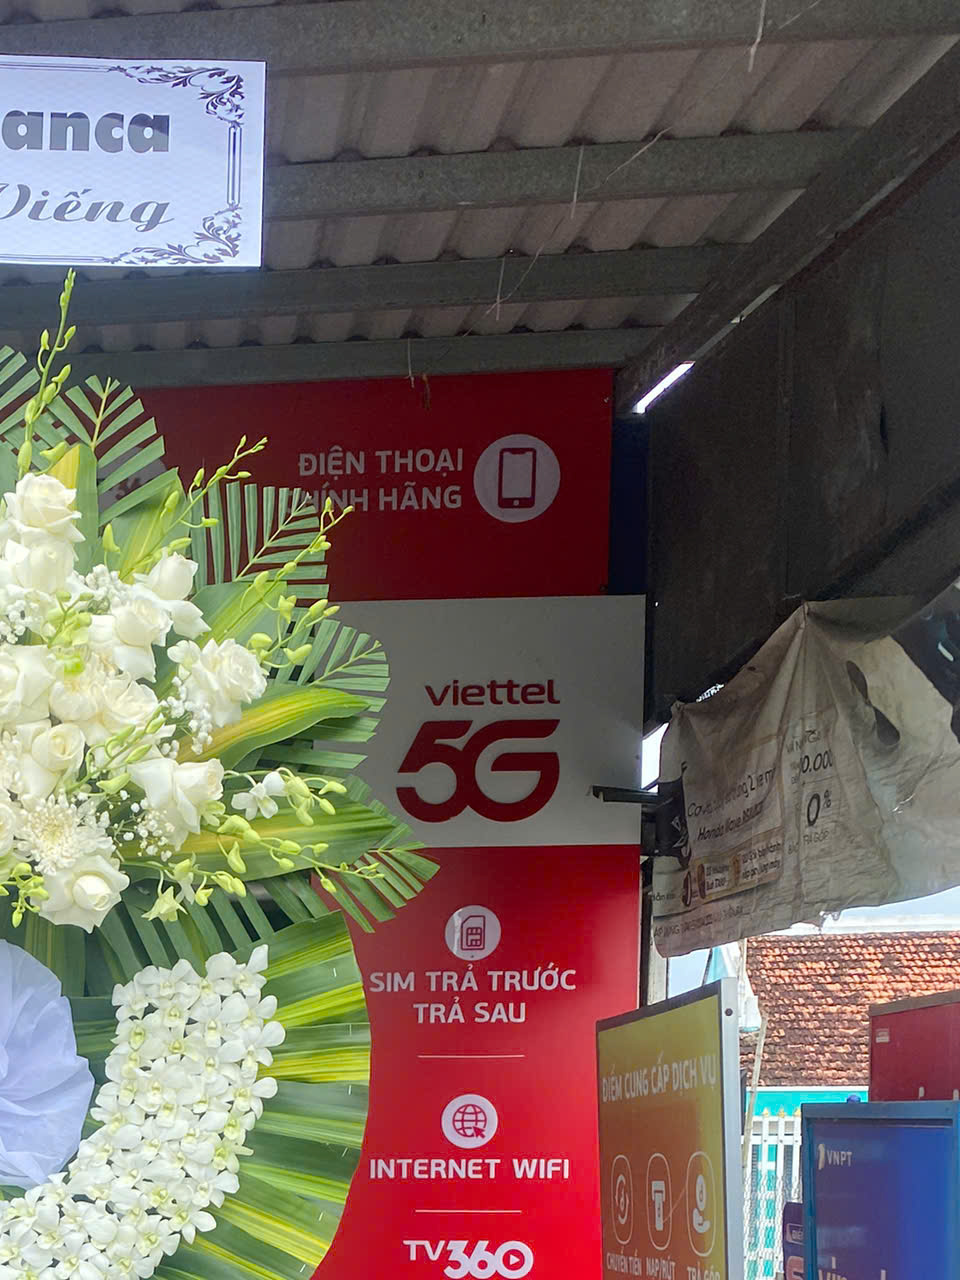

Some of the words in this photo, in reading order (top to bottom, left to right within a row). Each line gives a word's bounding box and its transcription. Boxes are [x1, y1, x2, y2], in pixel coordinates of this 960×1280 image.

[298, 445, 365, 479] ĐIỆN
[376, 448, 464, 477] THOẠI
[378, 481, 462, 511] HÃNG
[425, 679, 560, 706] viettel
[396, 719, 560, 823] 5G
[369, 971, 415, 992] SIM
[425, 964, 478, 992] TRẢ
[487, 962, 577, 991] TRƯỚC
[413, 996, 465, 1024] TRẢ
[474, 1002, 526, 1024] SAU
[624, 1067, 649, 1099] CUNG
[672, 1057, 698, 1097] DỊCH
[369, 1159, 501, 1179] INTERNET
[512, 1159, 569, 1179] WIFI
[826, 1150, 853, 1167] VNPT
[403, 1240, 534, 1280] TV360
